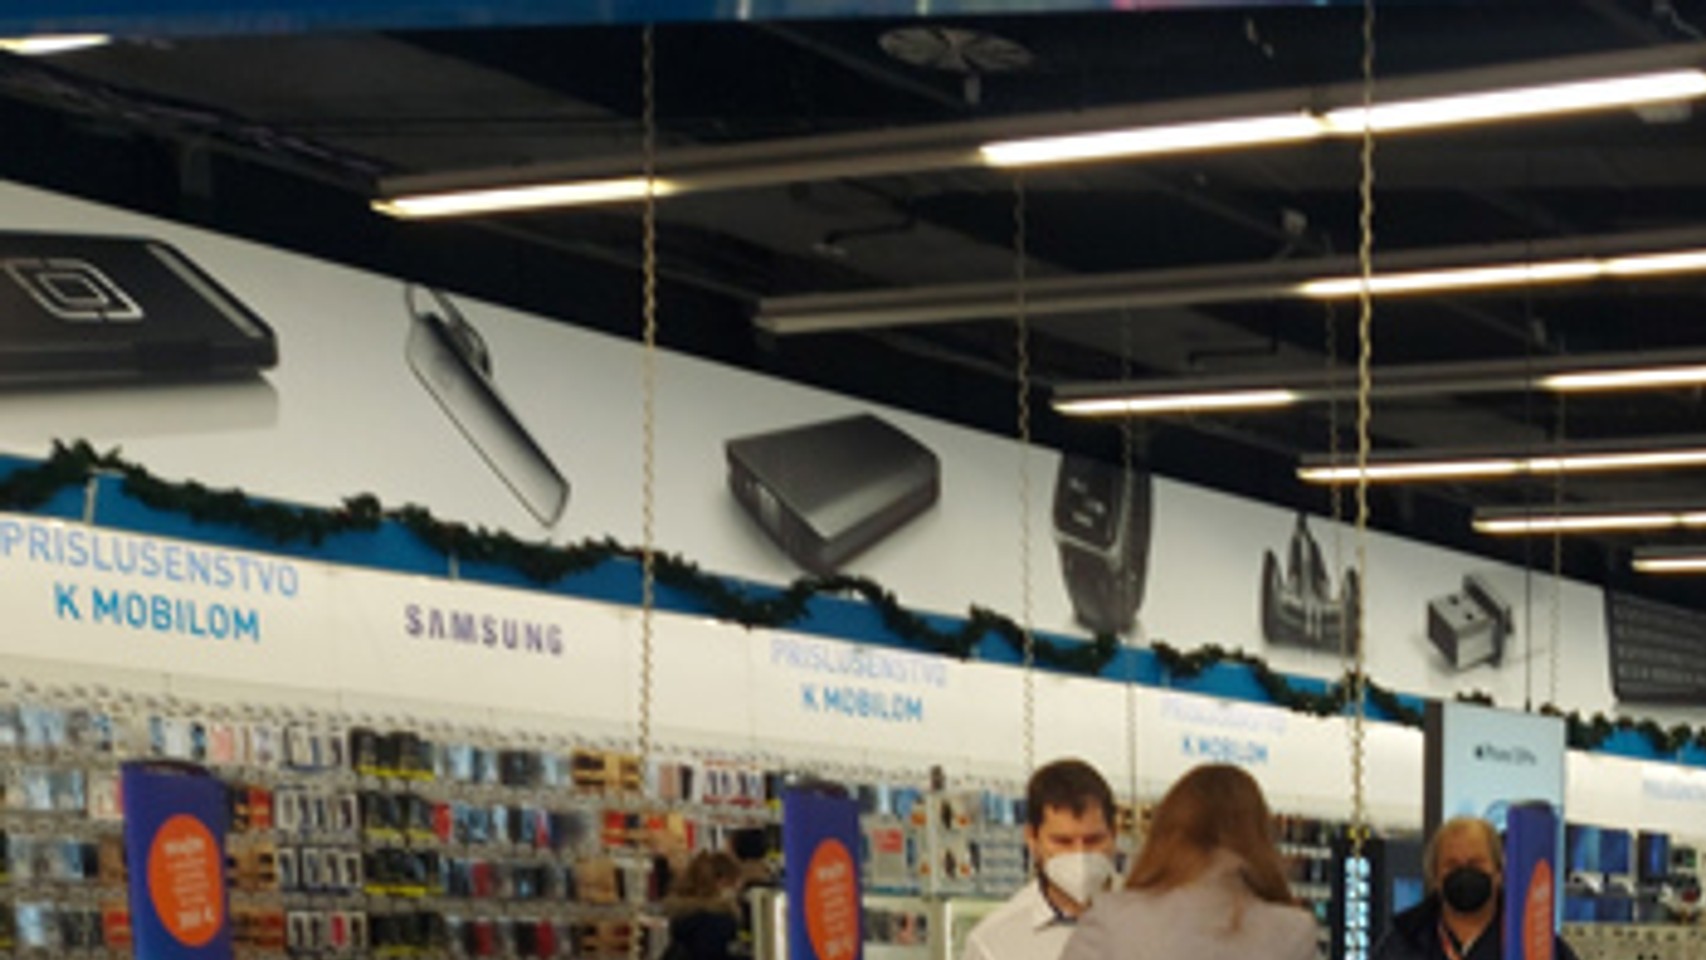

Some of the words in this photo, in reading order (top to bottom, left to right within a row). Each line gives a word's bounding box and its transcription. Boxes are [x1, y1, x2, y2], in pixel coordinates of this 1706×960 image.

[54, 583, 81, 620] K
[91, 586, 260, 643] MOBILOM
[404, 603, 563, 656] SAMSUNG
[801, 683, 819, 712] K
[823, 686, 923, 722] MOBILOM
